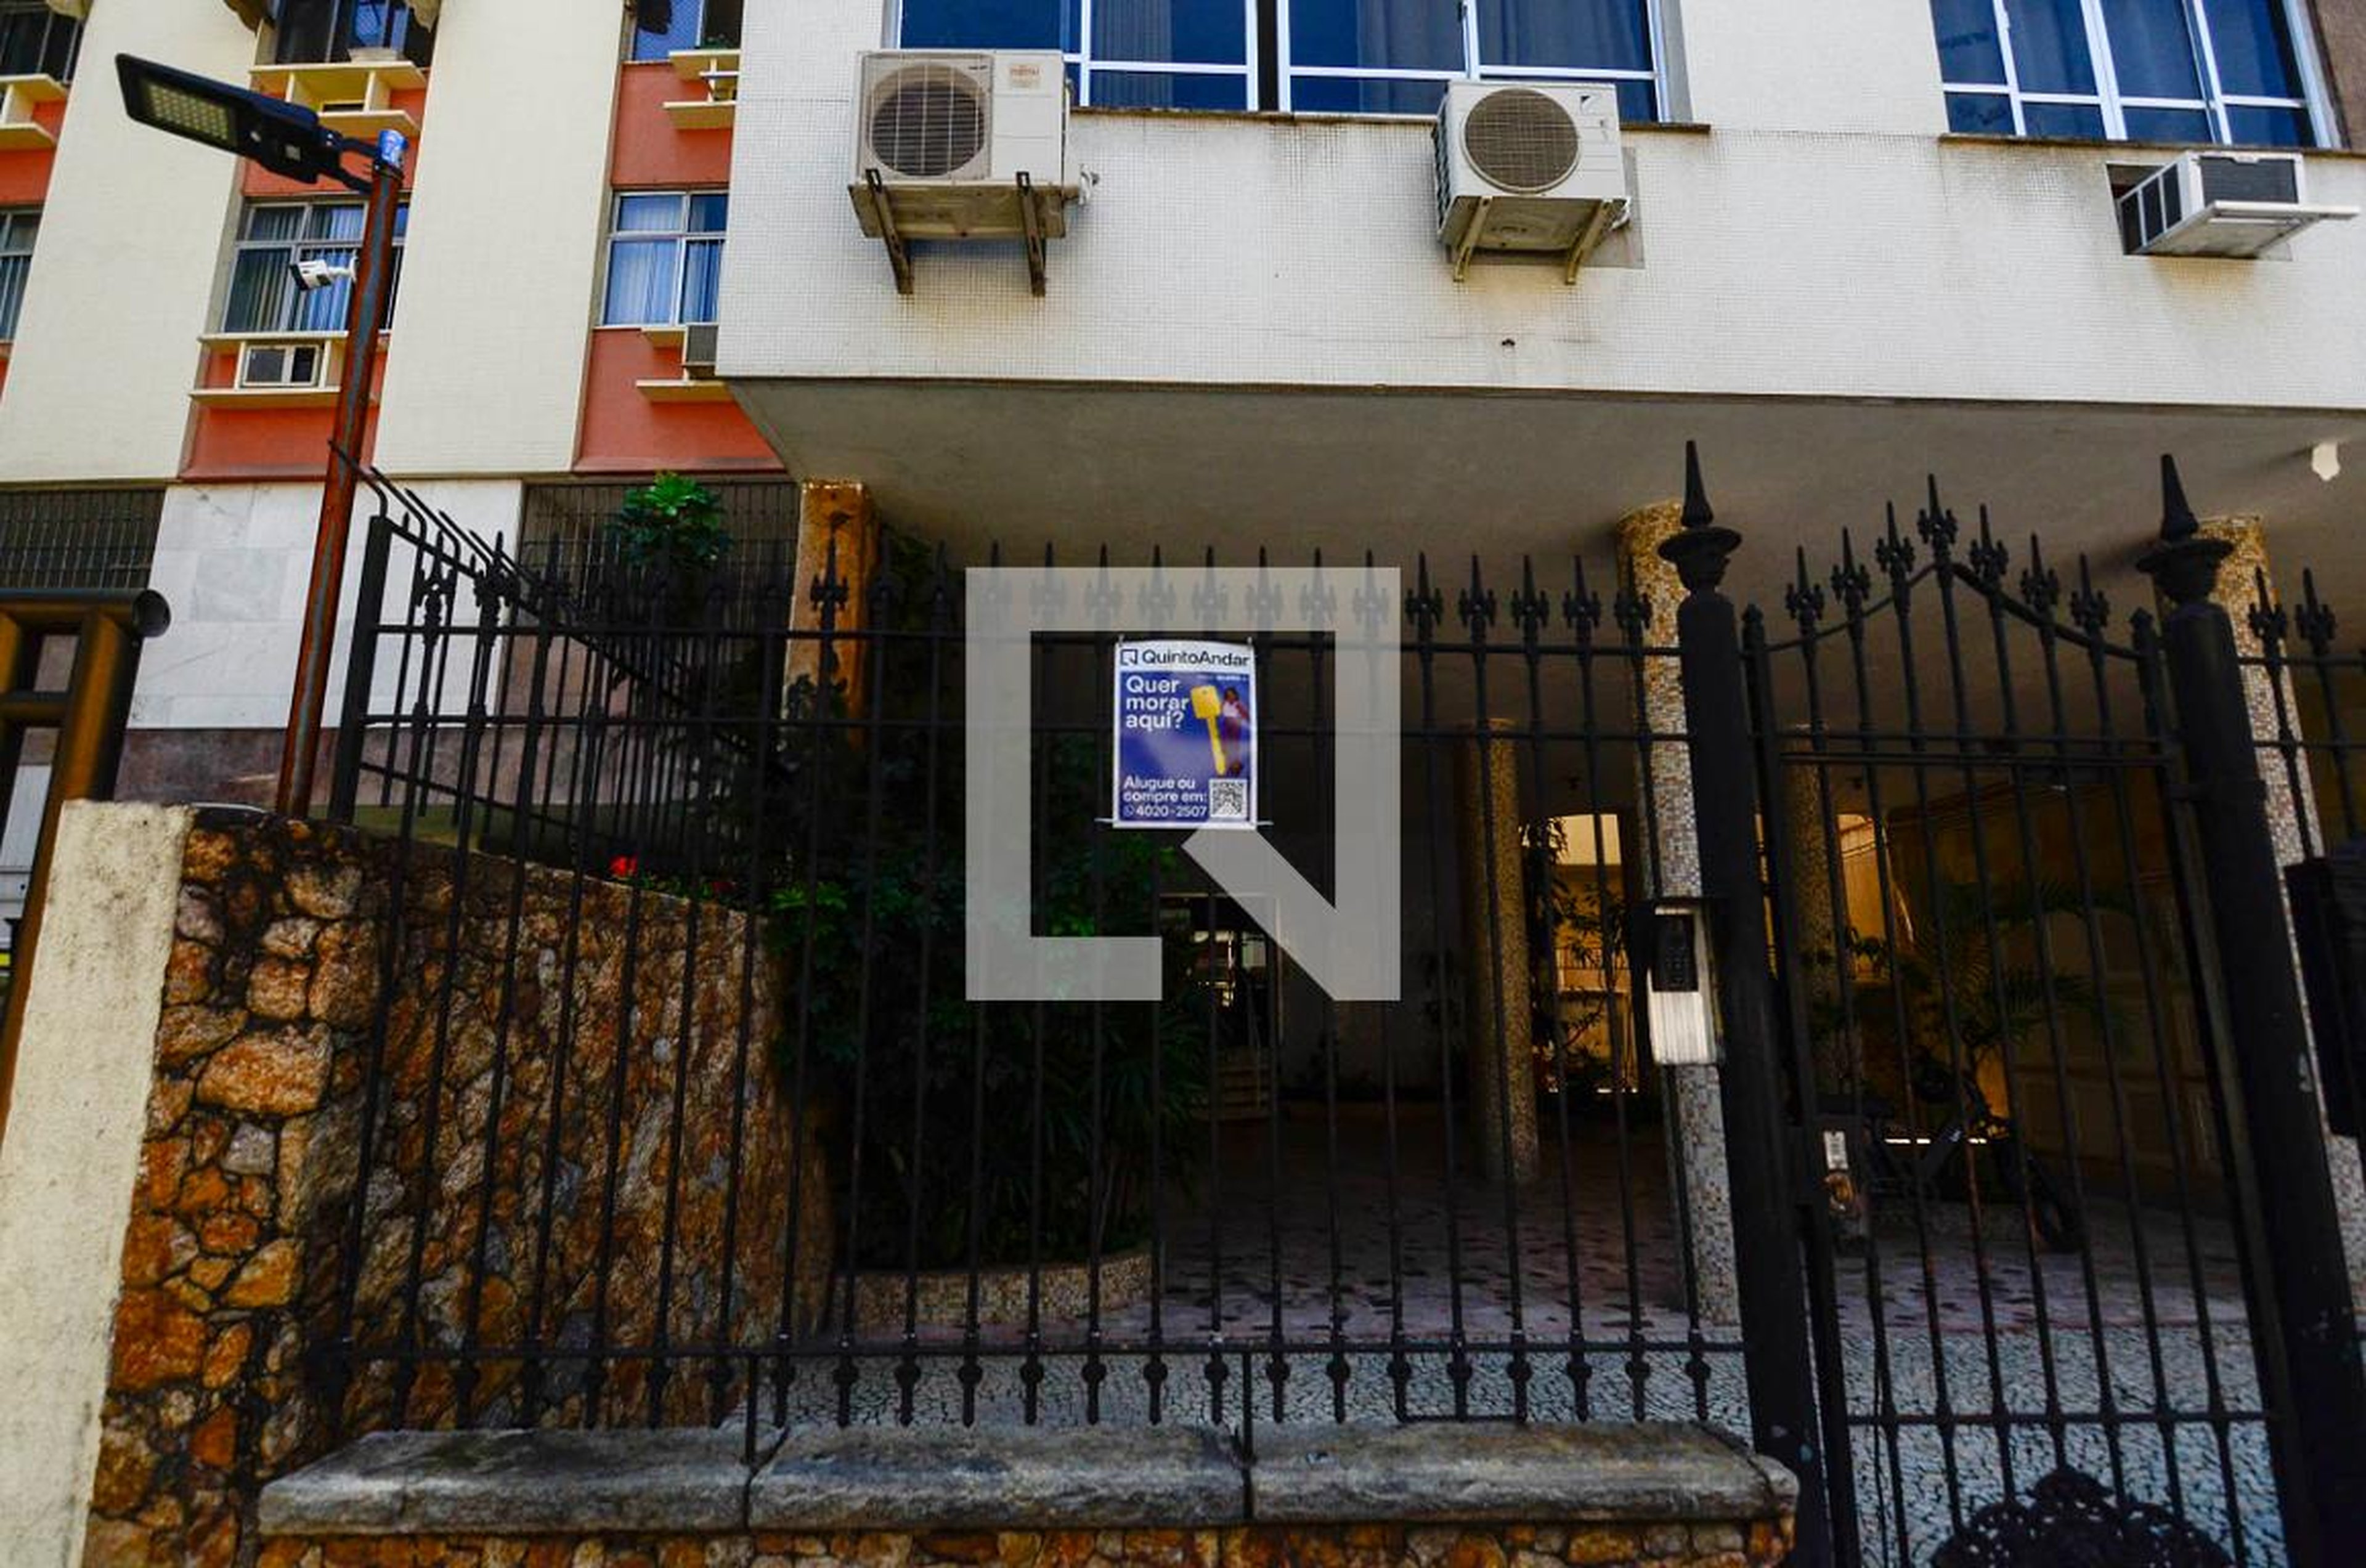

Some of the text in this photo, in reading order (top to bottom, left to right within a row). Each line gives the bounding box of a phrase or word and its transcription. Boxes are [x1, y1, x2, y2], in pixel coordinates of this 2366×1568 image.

[1142, 649, 1250, 666] QuintoAndar
[1126, 675, 1181, 694] Quer
[1126, 697, 1190, 710] morar
[1126, 712, 1184, 731] aqui?
[1123, 776, 1195, 792] Alugue ou
[1123, 792, 1208, 805] compre em:
